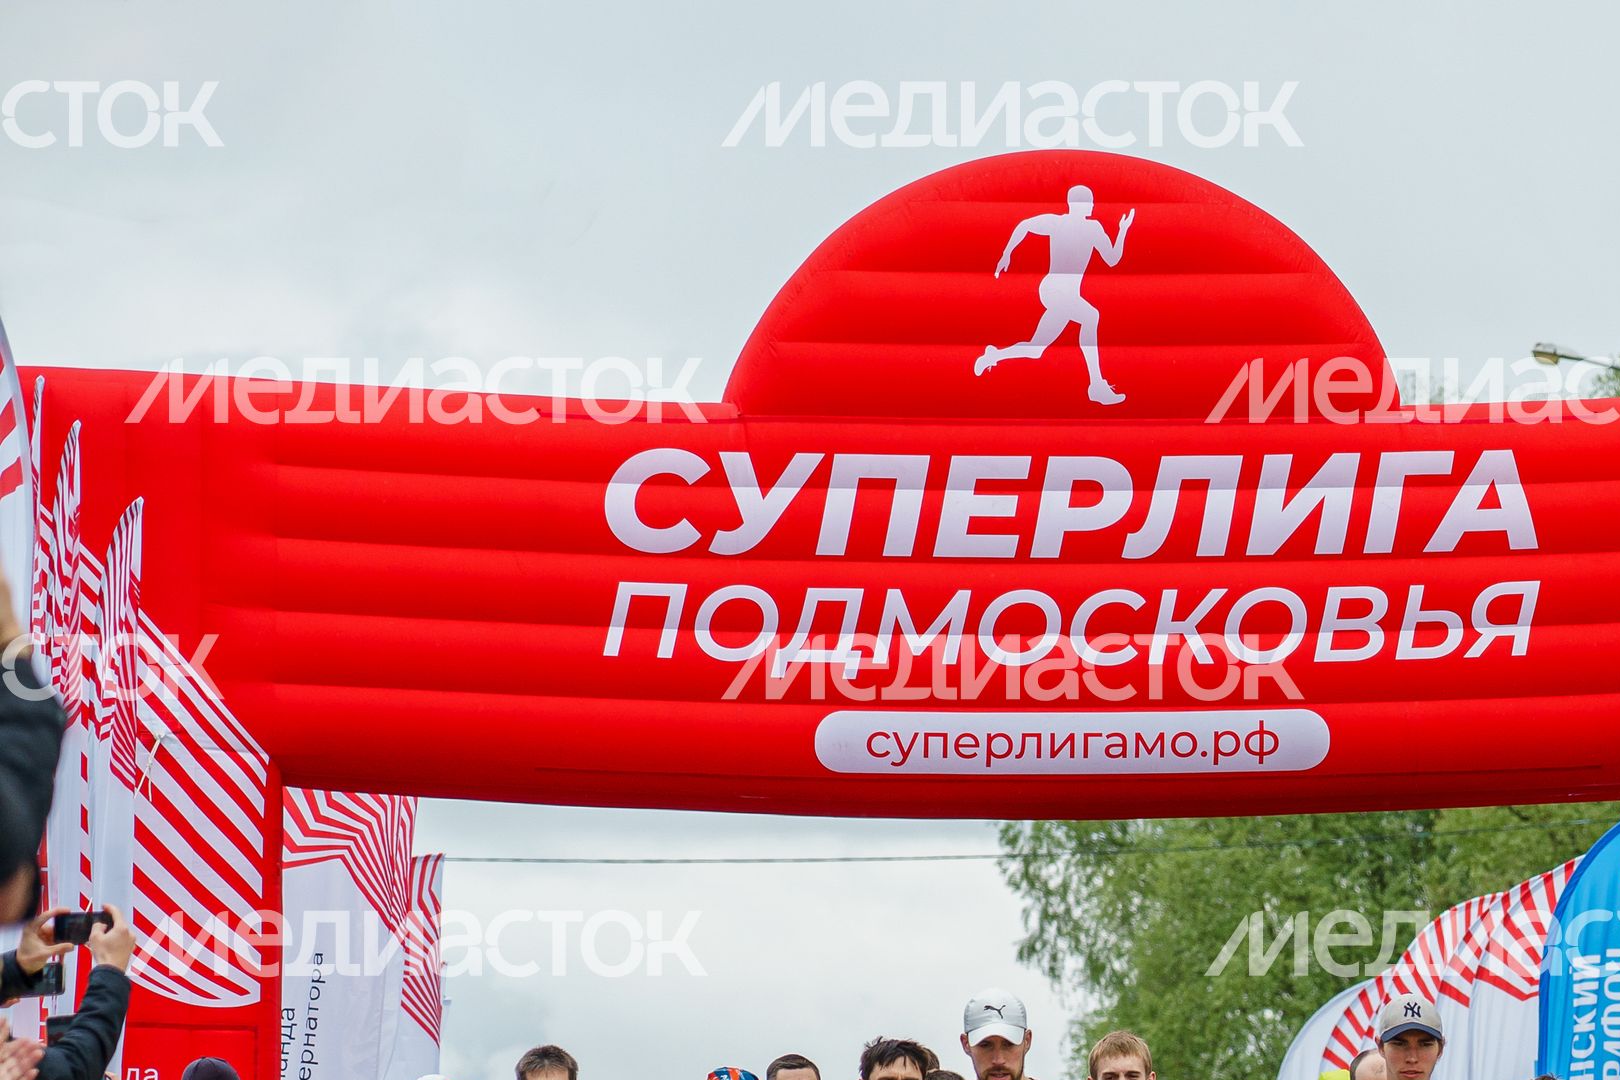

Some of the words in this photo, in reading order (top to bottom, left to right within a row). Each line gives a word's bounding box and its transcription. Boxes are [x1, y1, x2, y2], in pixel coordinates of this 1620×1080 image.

[604, 448, 1540, 560] СУПЕРЛИГА
[603, 579, 1541, 680] ПОДМОСКОВЬЯ
[866, 719, 1280, 764] суперлигамо.рф
